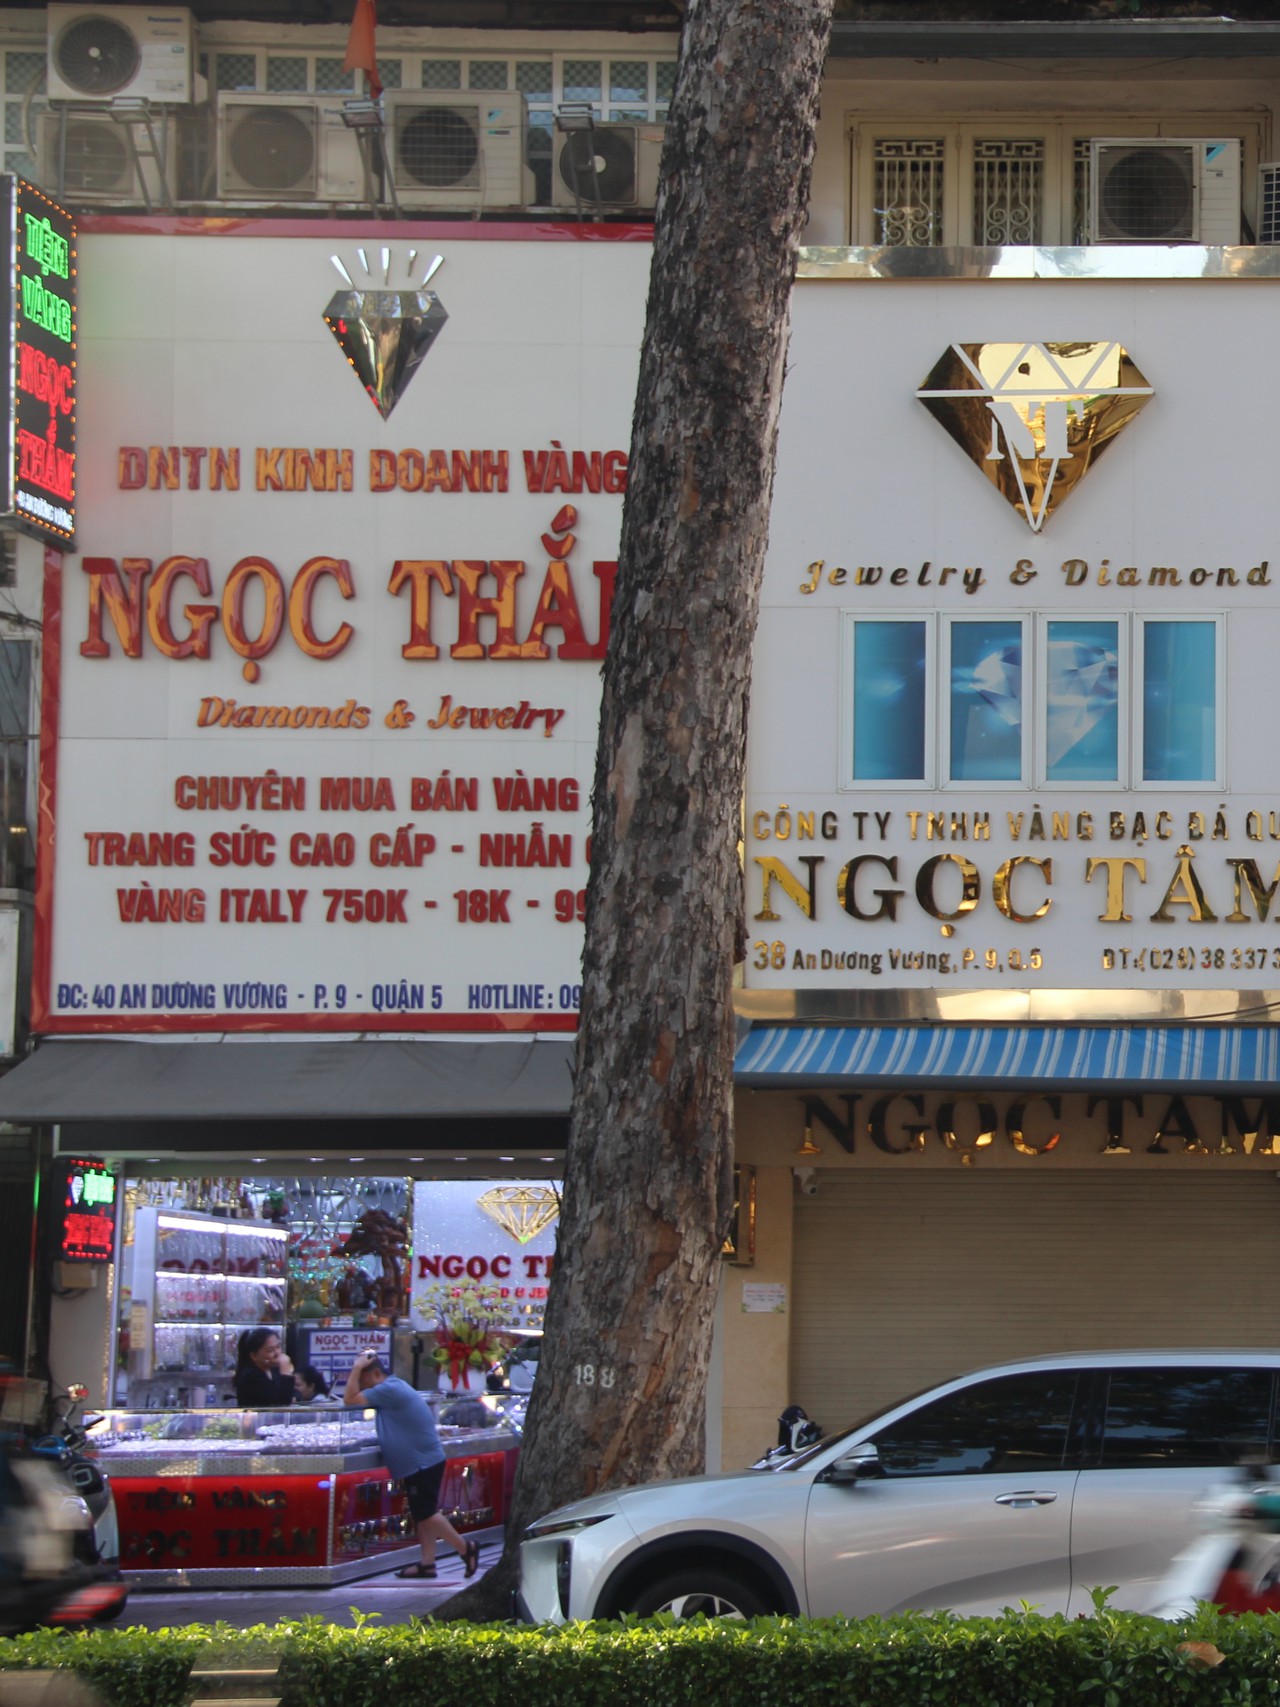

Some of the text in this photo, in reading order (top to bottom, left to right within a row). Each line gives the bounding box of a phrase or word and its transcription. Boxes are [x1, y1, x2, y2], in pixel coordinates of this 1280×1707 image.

[118, 440, 627, 494] DNTN KINH DOANH VÀNG
[799, 558, 1272, 595] Jewelry & Diamond
[80, 555, 355, 684] NGỌC
[197, 695, 566, 738] Diamonds & Jewelry
[175, 768, 580, 812] CHUYÊN MUA BÁN VÀNG
[84, 832, 195, 868] TRANG
[209, 823, 276, 868] SỨC
[289, 832, 355, 868] CAO
[370, 822, 436, 868] CẤP
[479, 821, 572, 868] NHẪN
[753, 804, 838, 841] CÔNG
[853, 811, 892, 841] TY
[907, 810, 991, 841] TNHH
[1006, 803, 1093, 841] VÀNG
[1109, 810, 1173, 847] BẠC
[1188, 803, 1229, 841] ĐÁ
[117, 881, 206, 923] VÀNG
[220, 889, 308, 923] ITALY
[325, 888, 409, 923] 750K
[453, 888, 512, 923] 18K
[753, 853, 1053, 938] NGỌC
[753, 940, 786, 970] 38
[792, 949, 816, 970] An
[820, 948, 883, 975] Dương
[57, 983, 88, 1009] ĐC:
[92, 984, 116, 1009] 40
[119, 984, 147, 1009] AN
[152, 981, 216, 1009] DƯƠNG
[223, 981, 288, 1009] VƯƠNG
[371, 979, 424, 1013] QUẬN
[431, 984, 443, 1009] 5
[799, 1092, 1061, 1166] NGỌC
[418, 1254, 512, 1282] NGỌC
